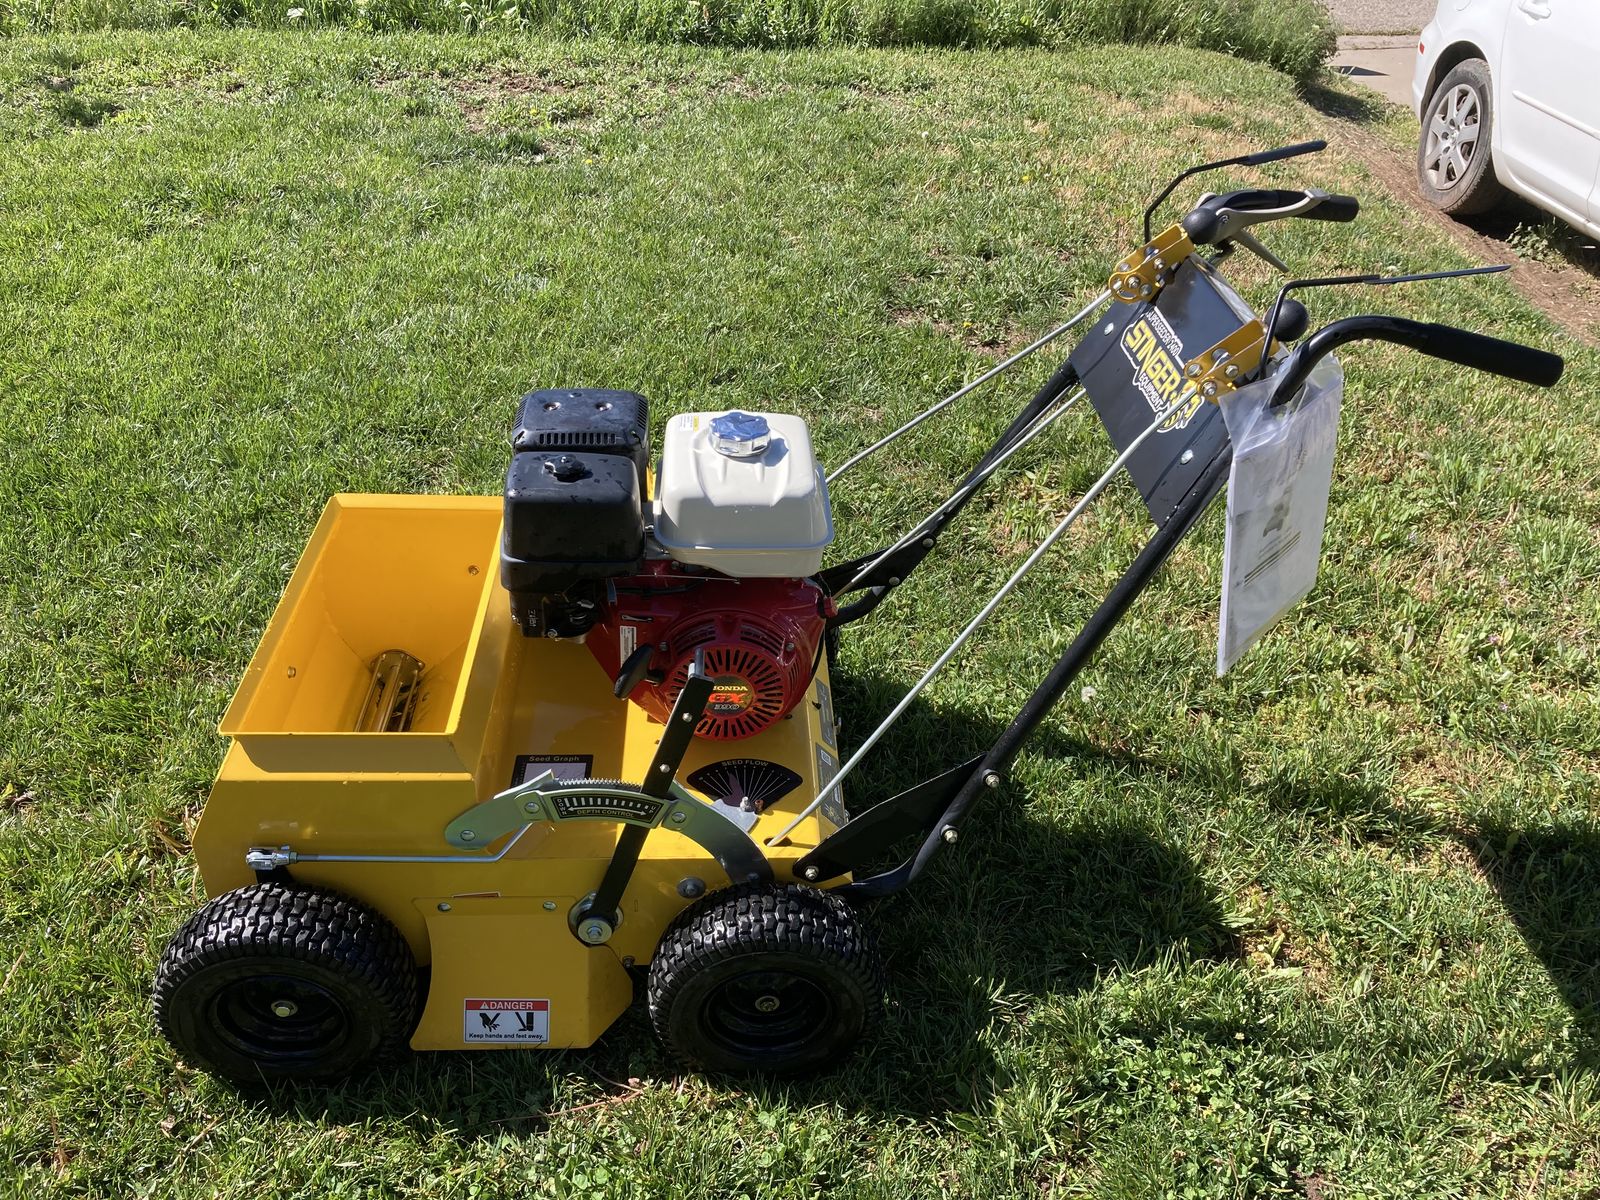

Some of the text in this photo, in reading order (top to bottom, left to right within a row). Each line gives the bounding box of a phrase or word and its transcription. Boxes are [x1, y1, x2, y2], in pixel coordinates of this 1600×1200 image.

[1126, 319, 1182, 402] STINGER
[1138, 372, 1164, 411] EQUIPMENT
[709, 692, 748, 704] GX
[601, 808, 634, 818] CONTROL
[490, 1001, 534, 1010] DANGER
